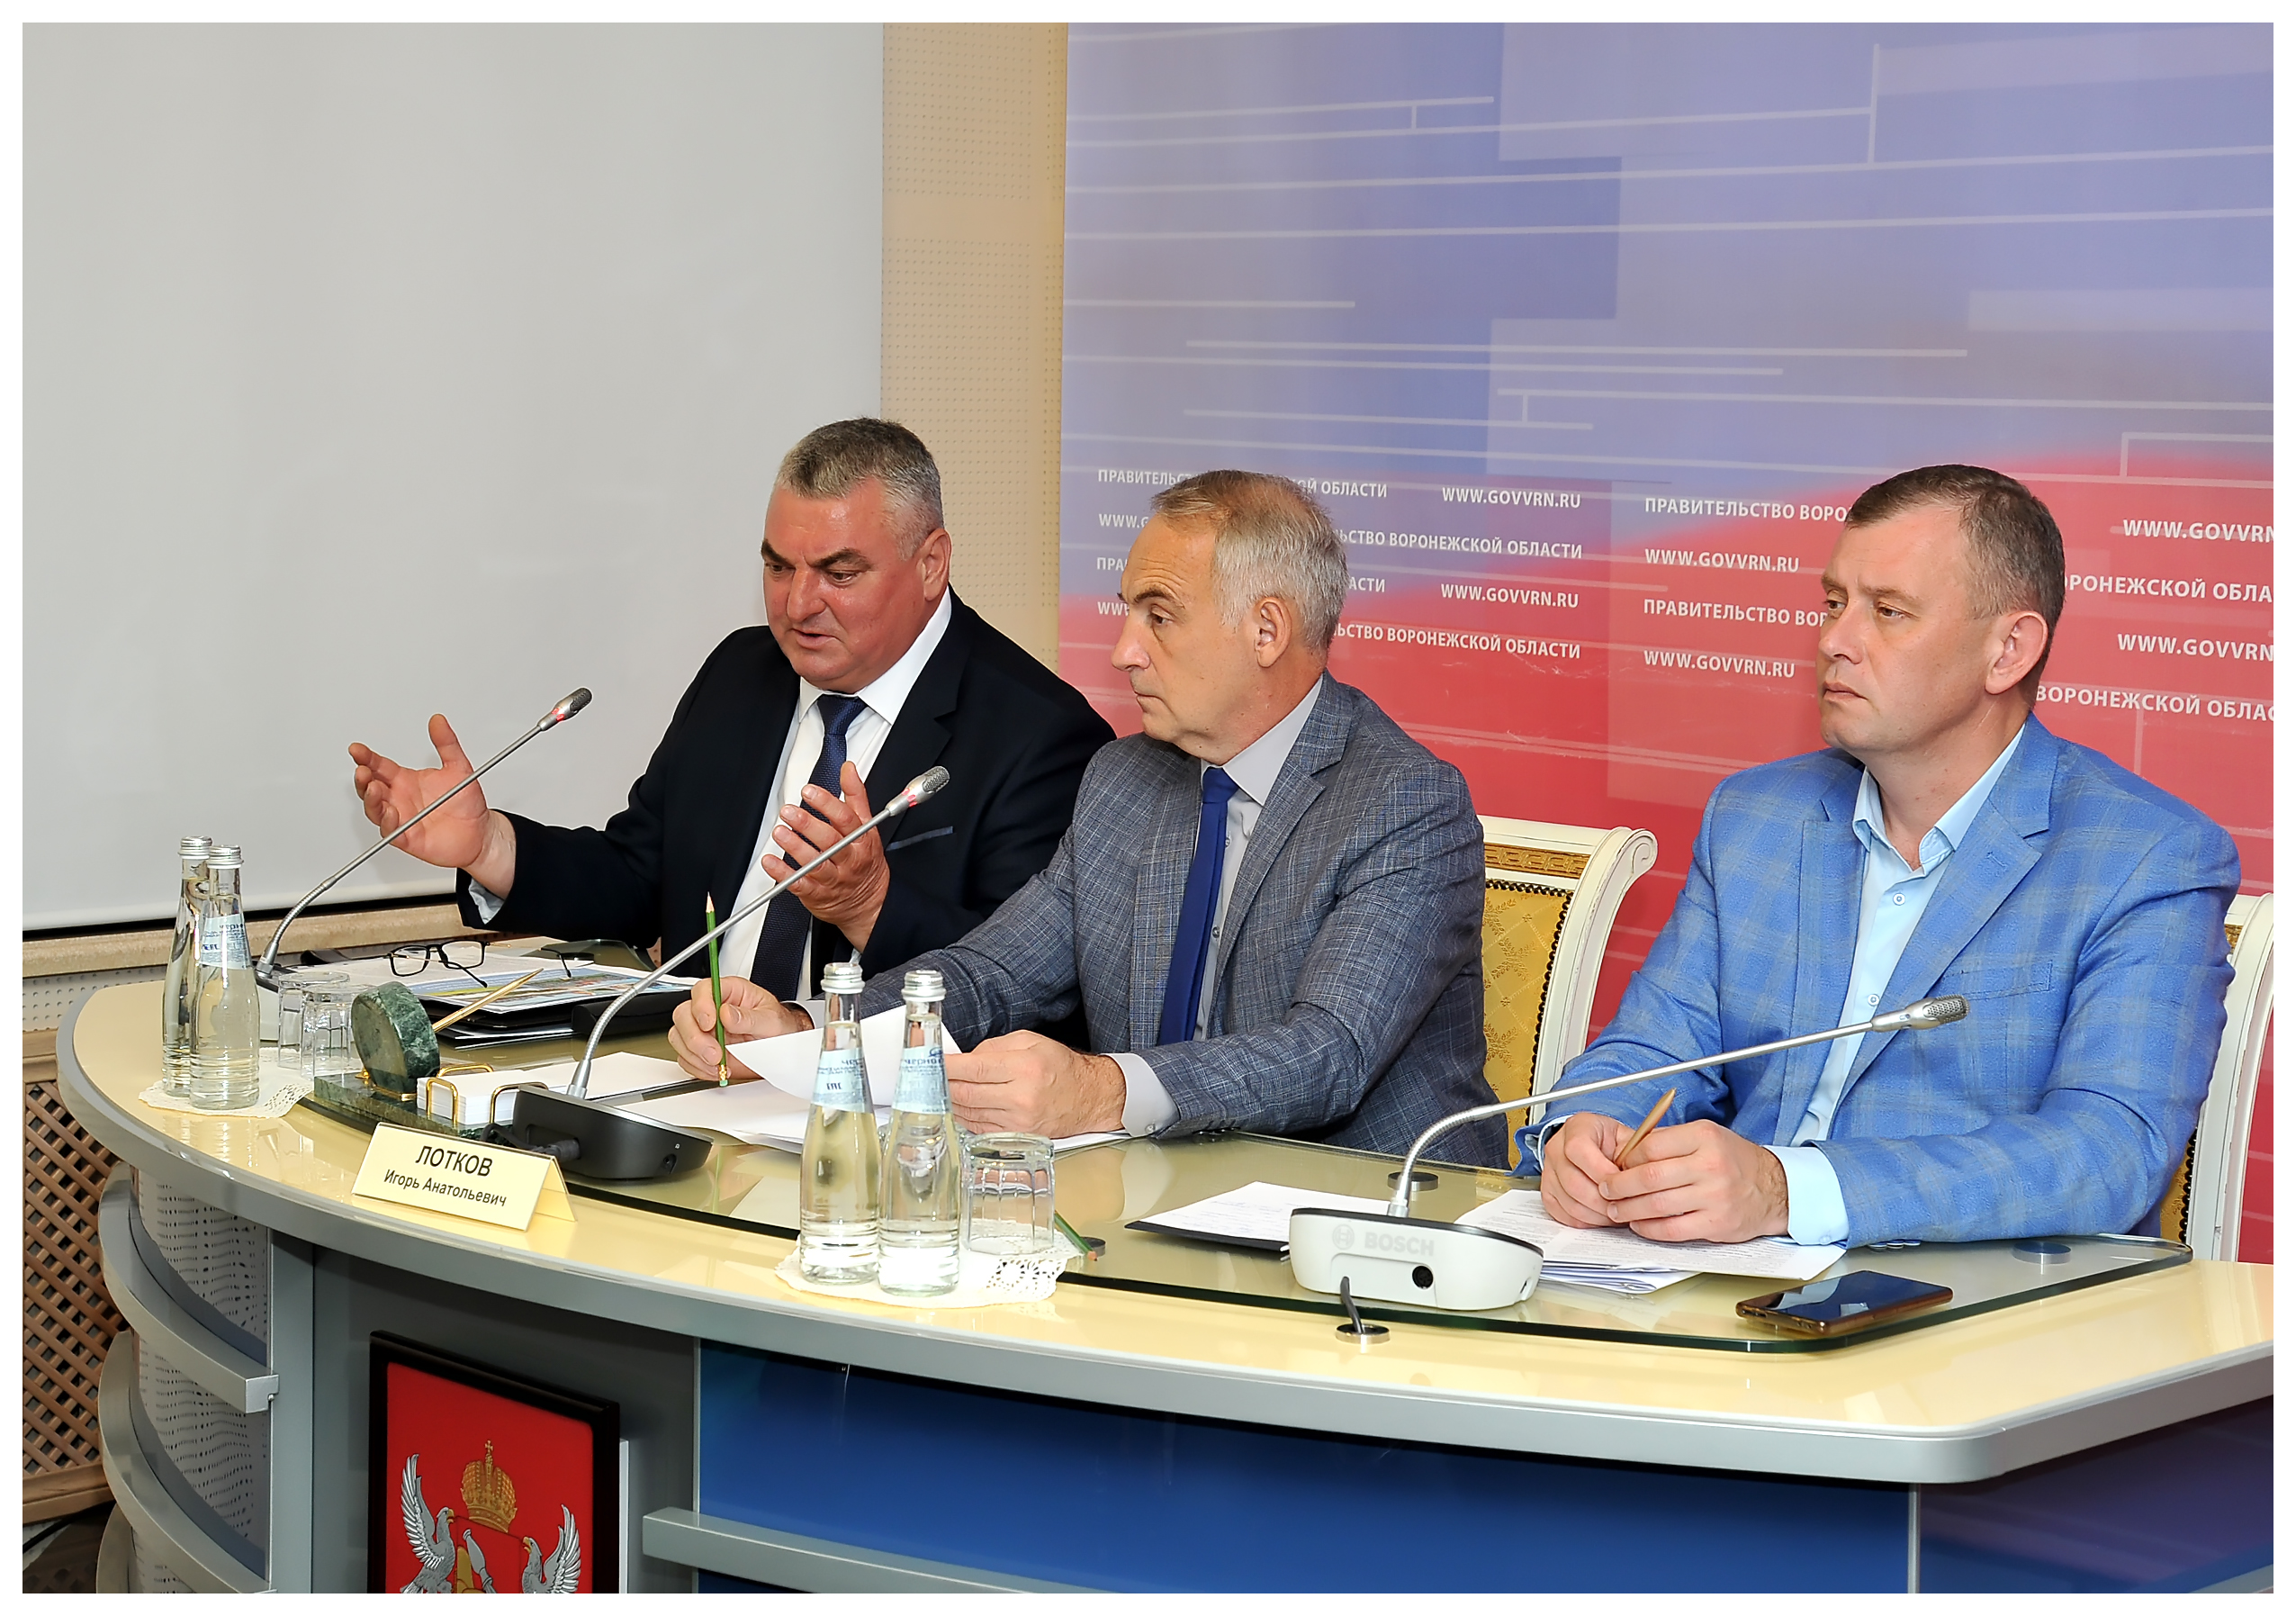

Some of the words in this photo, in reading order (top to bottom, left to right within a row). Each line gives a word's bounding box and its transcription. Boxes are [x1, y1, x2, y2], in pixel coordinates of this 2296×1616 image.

[1321, 481, 1387, 498] ОБЛАСТИ
[1442, 487, 1581, 509] WWW.GOVVRN.RU
[1099, 513, 1148, 528] WWW.G
[1645, 497, 1795, 519] ПРАВИТЕЛЬСТВО
[1799, 504, 1849, 522] ВОРО
[1335, 528, 1385, 546] ЬСТВО
[1390, 532, 1502, 554] ВОРОНЕЖСКОЙ
[1508, 540, 1582, 559] ОБЛАСТИ
[1097, 556, 1128, 572] ПРА
[1348, 576, 1385, 593] АСТИ
[1644, 548, 1799, 573] WWW.GOVVRN.RU
[1441, 583, 1580, 608] WWW.GOVVRN.RU
[2065, 574, 2206, 599] РОНЕЖСКОЙ
[2212, 582, 2273, 603] ОБЛА
[1643, 599, 1790, 624] ПРАВИТЕЛЬСТВО
[1795, 610, 1829, 627] ВОР
[1387, 627, 1501, 652] ВОРОНЕЖСКОЙ
[1506, 638, 1581, 659] ОБЛАСТИ
[1643, 649, 1796, 678] WWW.GOVVRN.RU
[2036, 685, 2201, 715] ВОРОНЕЖСКОЙ
[415, 1145, 493, 1177] ЛОТКОВ
[383, 1169, 420, 1189] Игорь
[421, 1178, 507, 1206] Анатольевич
[1364, 1232, 1435, 1256] BOSCH
